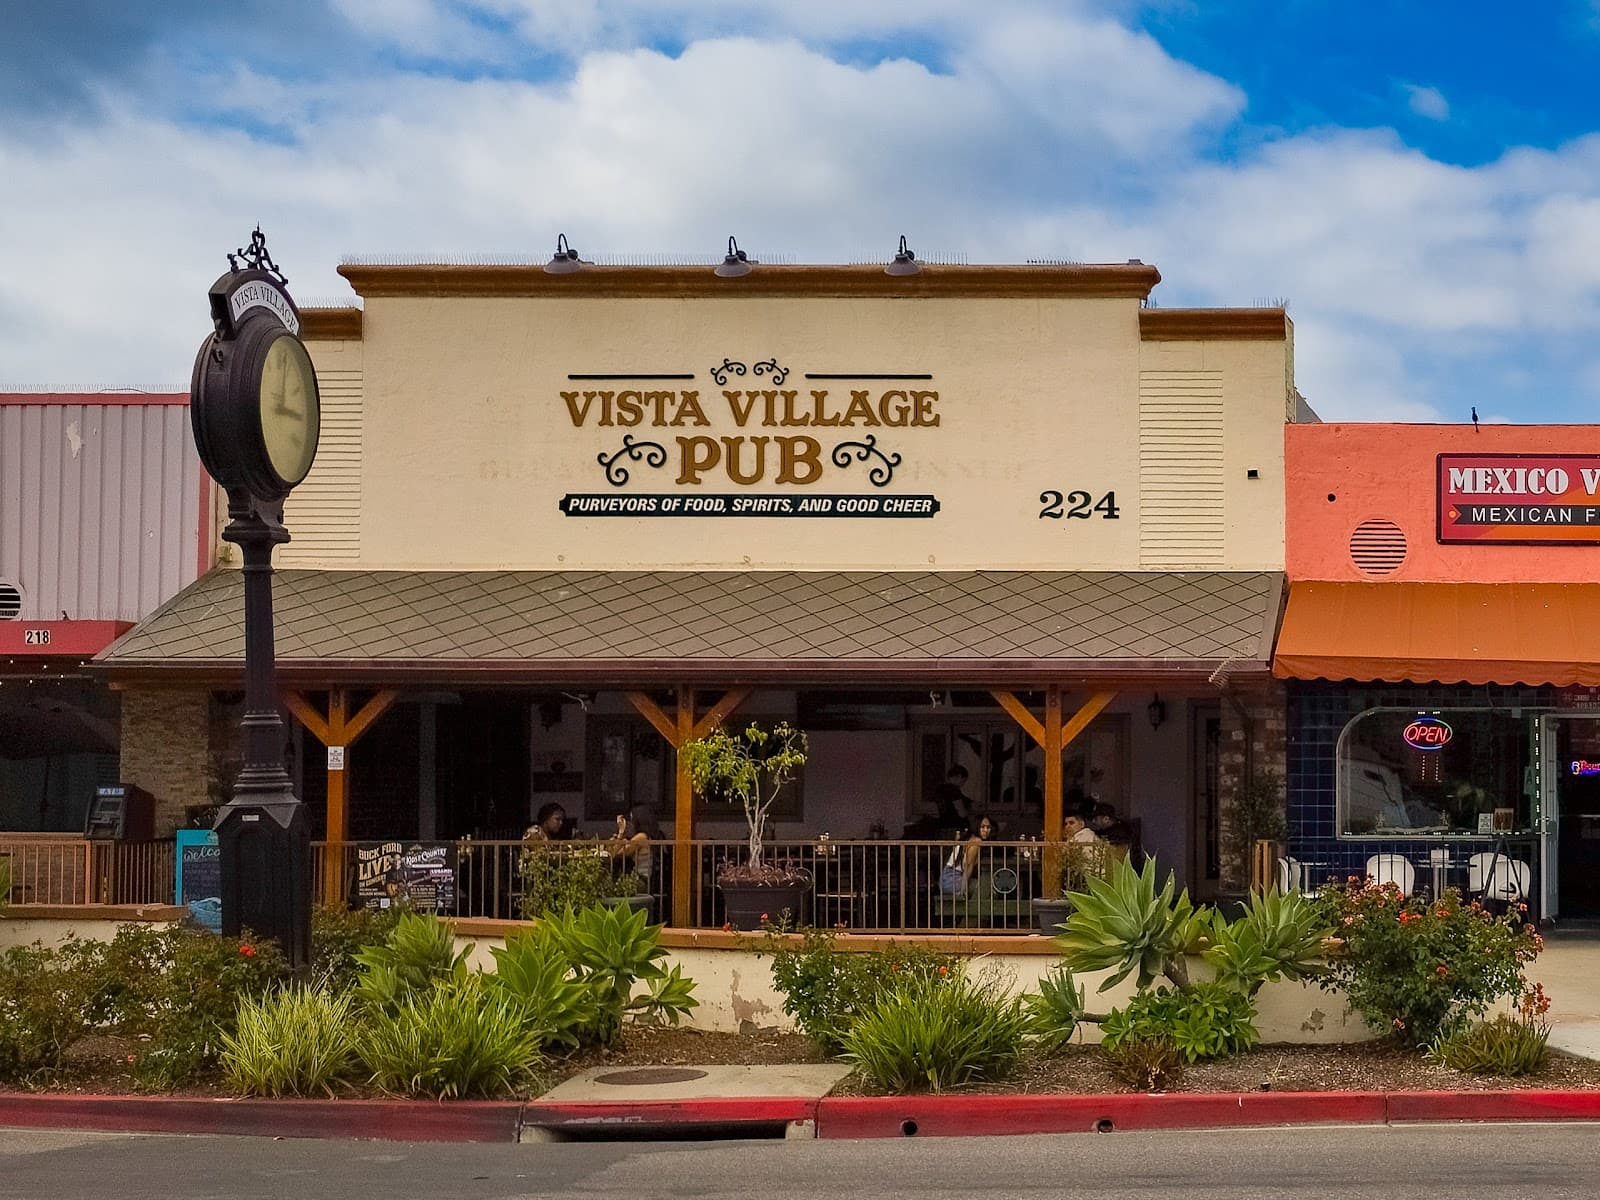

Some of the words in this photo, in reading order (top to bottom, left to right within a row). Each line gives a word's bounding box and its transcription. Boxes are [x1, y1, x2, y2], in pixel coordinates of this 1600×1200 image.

[235, 286, 259, 309] VISTA
[260, 286, 297, 333] VILLAGE
[560, 390, 711, 427] VISTA
[722, 390, 940, 427] VILLAGE
[675, 435, 823, 485] PUB
[1448, 467, 1569, 495] MEXICO
[568, 498, 658, 512] PURVEYORS
[661, 498, 682, 512] OF
[684, 498, 727, 513] FOOD,
[731, 498, 794, 513] SPIRITS,
[798, 498, 832, 513] AND
[836, 498, 878, 513] GOOD
[883, 498, 932, 513] CHEER
[1039, 490, 1120, 520] 224
[1472, 507, 1572, 523] MEXICAN
[26, 631, 49, 644] 218
[1406, 726, 1448, 742] OPEN
[183, 846, 221, 861] welco
[358, 854, 392, 881] LIVE
